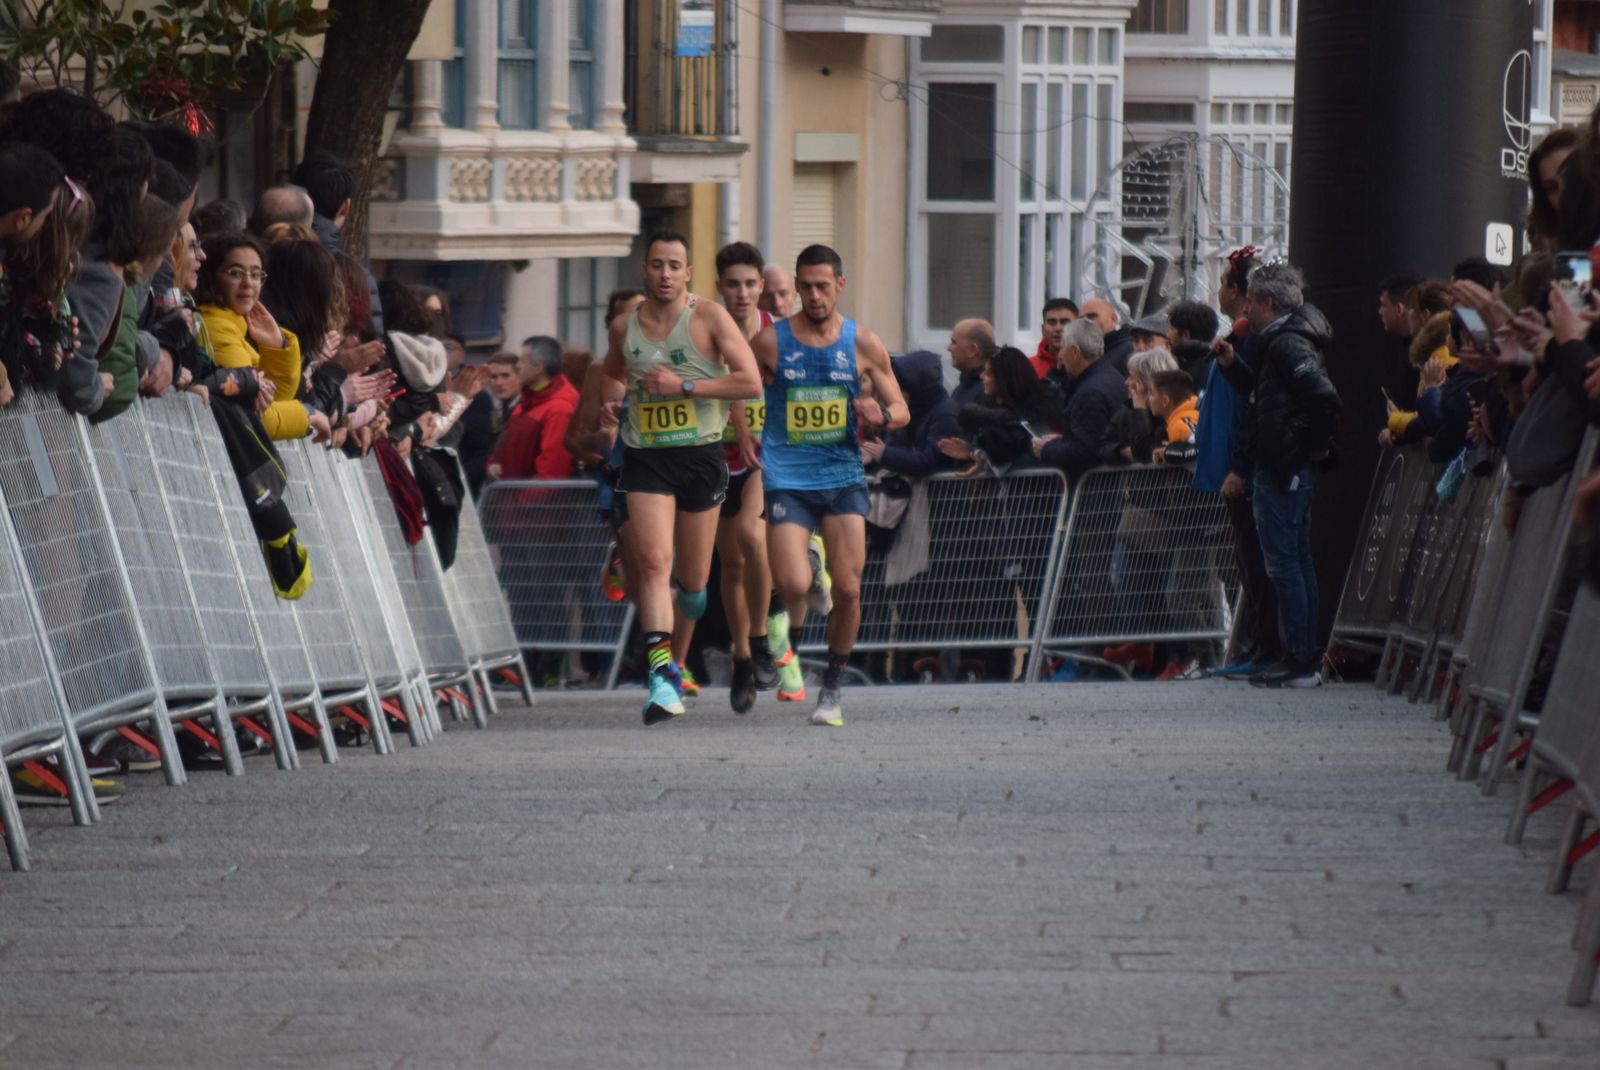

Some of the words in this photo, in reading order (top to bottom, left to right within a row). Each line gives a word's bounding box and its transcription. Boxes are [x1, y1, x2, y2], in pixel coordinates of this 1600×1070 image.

[1501, 148, 1529, 174] DS
[642, 404, 689, 430] 706
[741, 405, 766, 428] 89
[793, 403, 841, 429] 996
